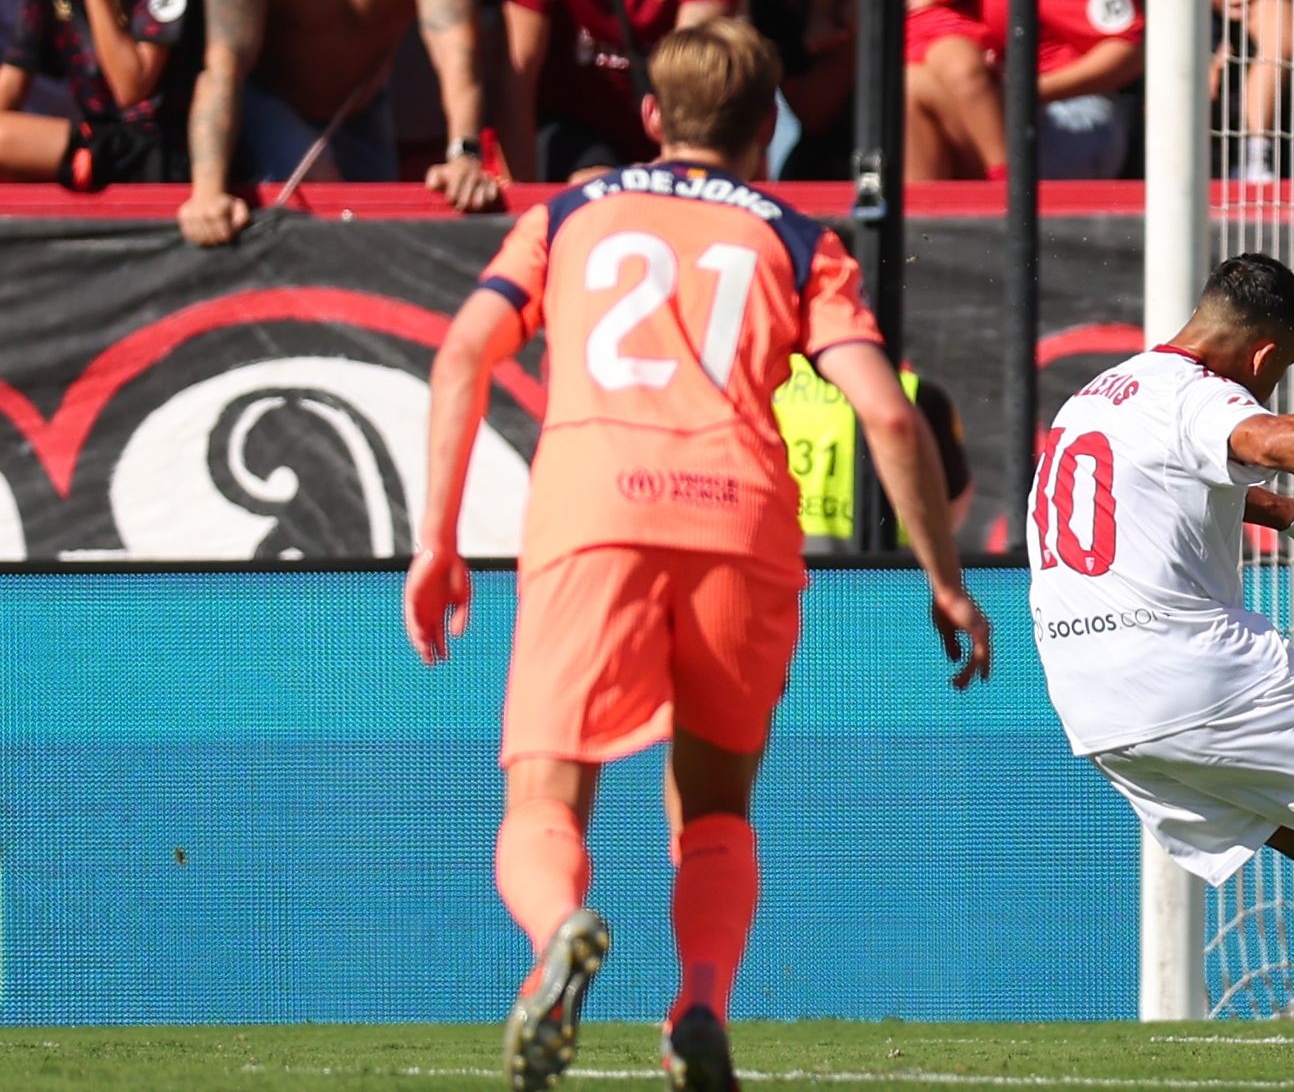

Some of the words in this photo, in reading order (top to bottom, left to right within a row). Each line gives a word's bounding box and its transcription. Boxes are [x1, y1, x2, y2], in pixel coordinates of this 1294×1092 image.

[621, 167, 675, 194] DE
[675, 177, 783, 221] JONG
[584, 231, 758, 390] 21
[1032, 426, 1117, 577] 10
